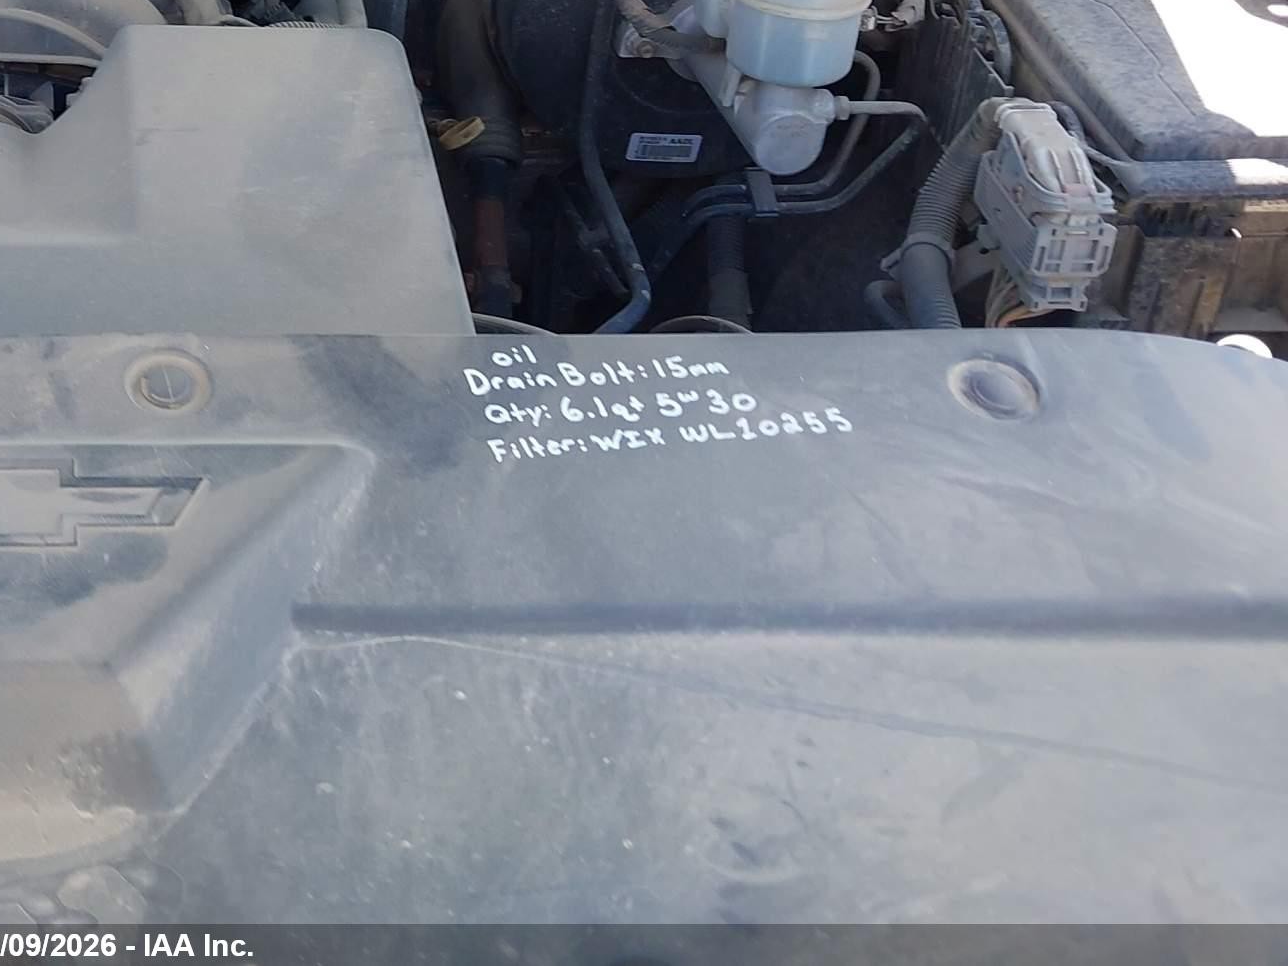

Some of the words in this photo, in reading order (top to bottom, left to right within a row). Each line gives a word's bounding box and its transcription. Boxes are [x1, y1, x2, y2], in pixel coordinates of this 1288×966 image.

[463, 367, 558, 396] Drain
[557, 360, 649, 387] Bolt:
[651, 355, 730, 380] 15mm
[484, 403, 552, 427] Qty:
[487, 436, 588, 464] Filter:
[590, 427, 666, 452] WIX
